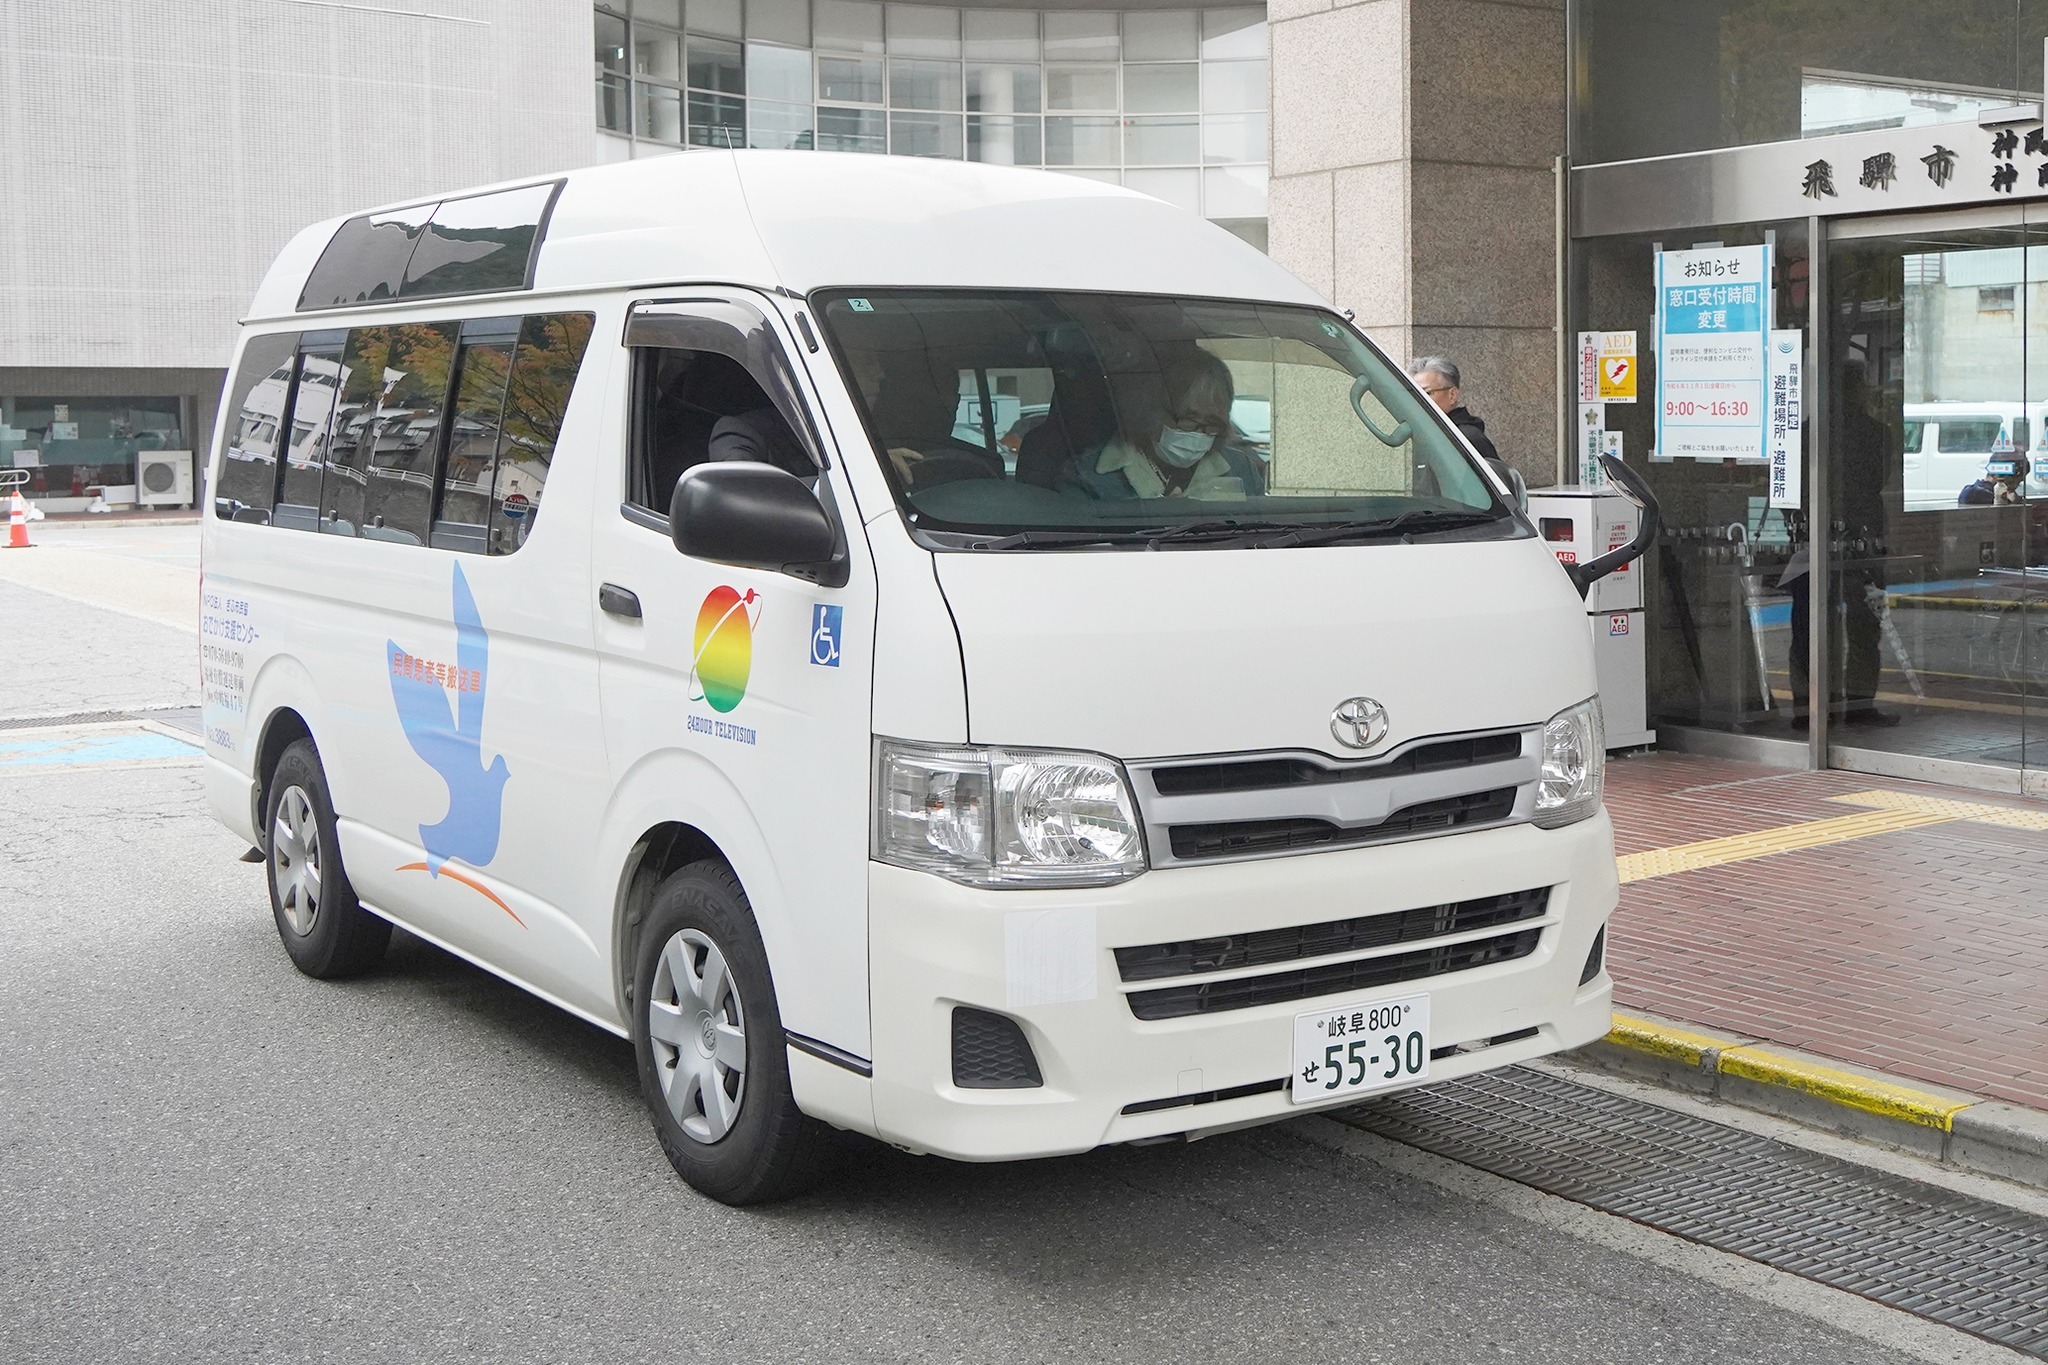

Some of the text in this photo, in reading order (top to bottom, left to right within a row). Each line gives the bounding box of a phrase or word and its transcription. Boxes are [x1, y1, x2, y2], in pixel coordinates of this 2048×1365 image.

[1802, 144, 1959, 200] 飛騨市
[1684, 258, 1740, 277] お知らせ
[1669, 285, 1756, 307] 窓口受付時間
[1698, 310, 1727, 328] 変更
[1604, 335, 1632, 348] AED
[1773, 375, 1787, 498] 避難場所・避難所
[1558, 553, 1575, 562] AED
[393, 652, 481, 694] 民間患者等搬送車
[687, 714, 757, 746] 24HOUR TELEVISION
